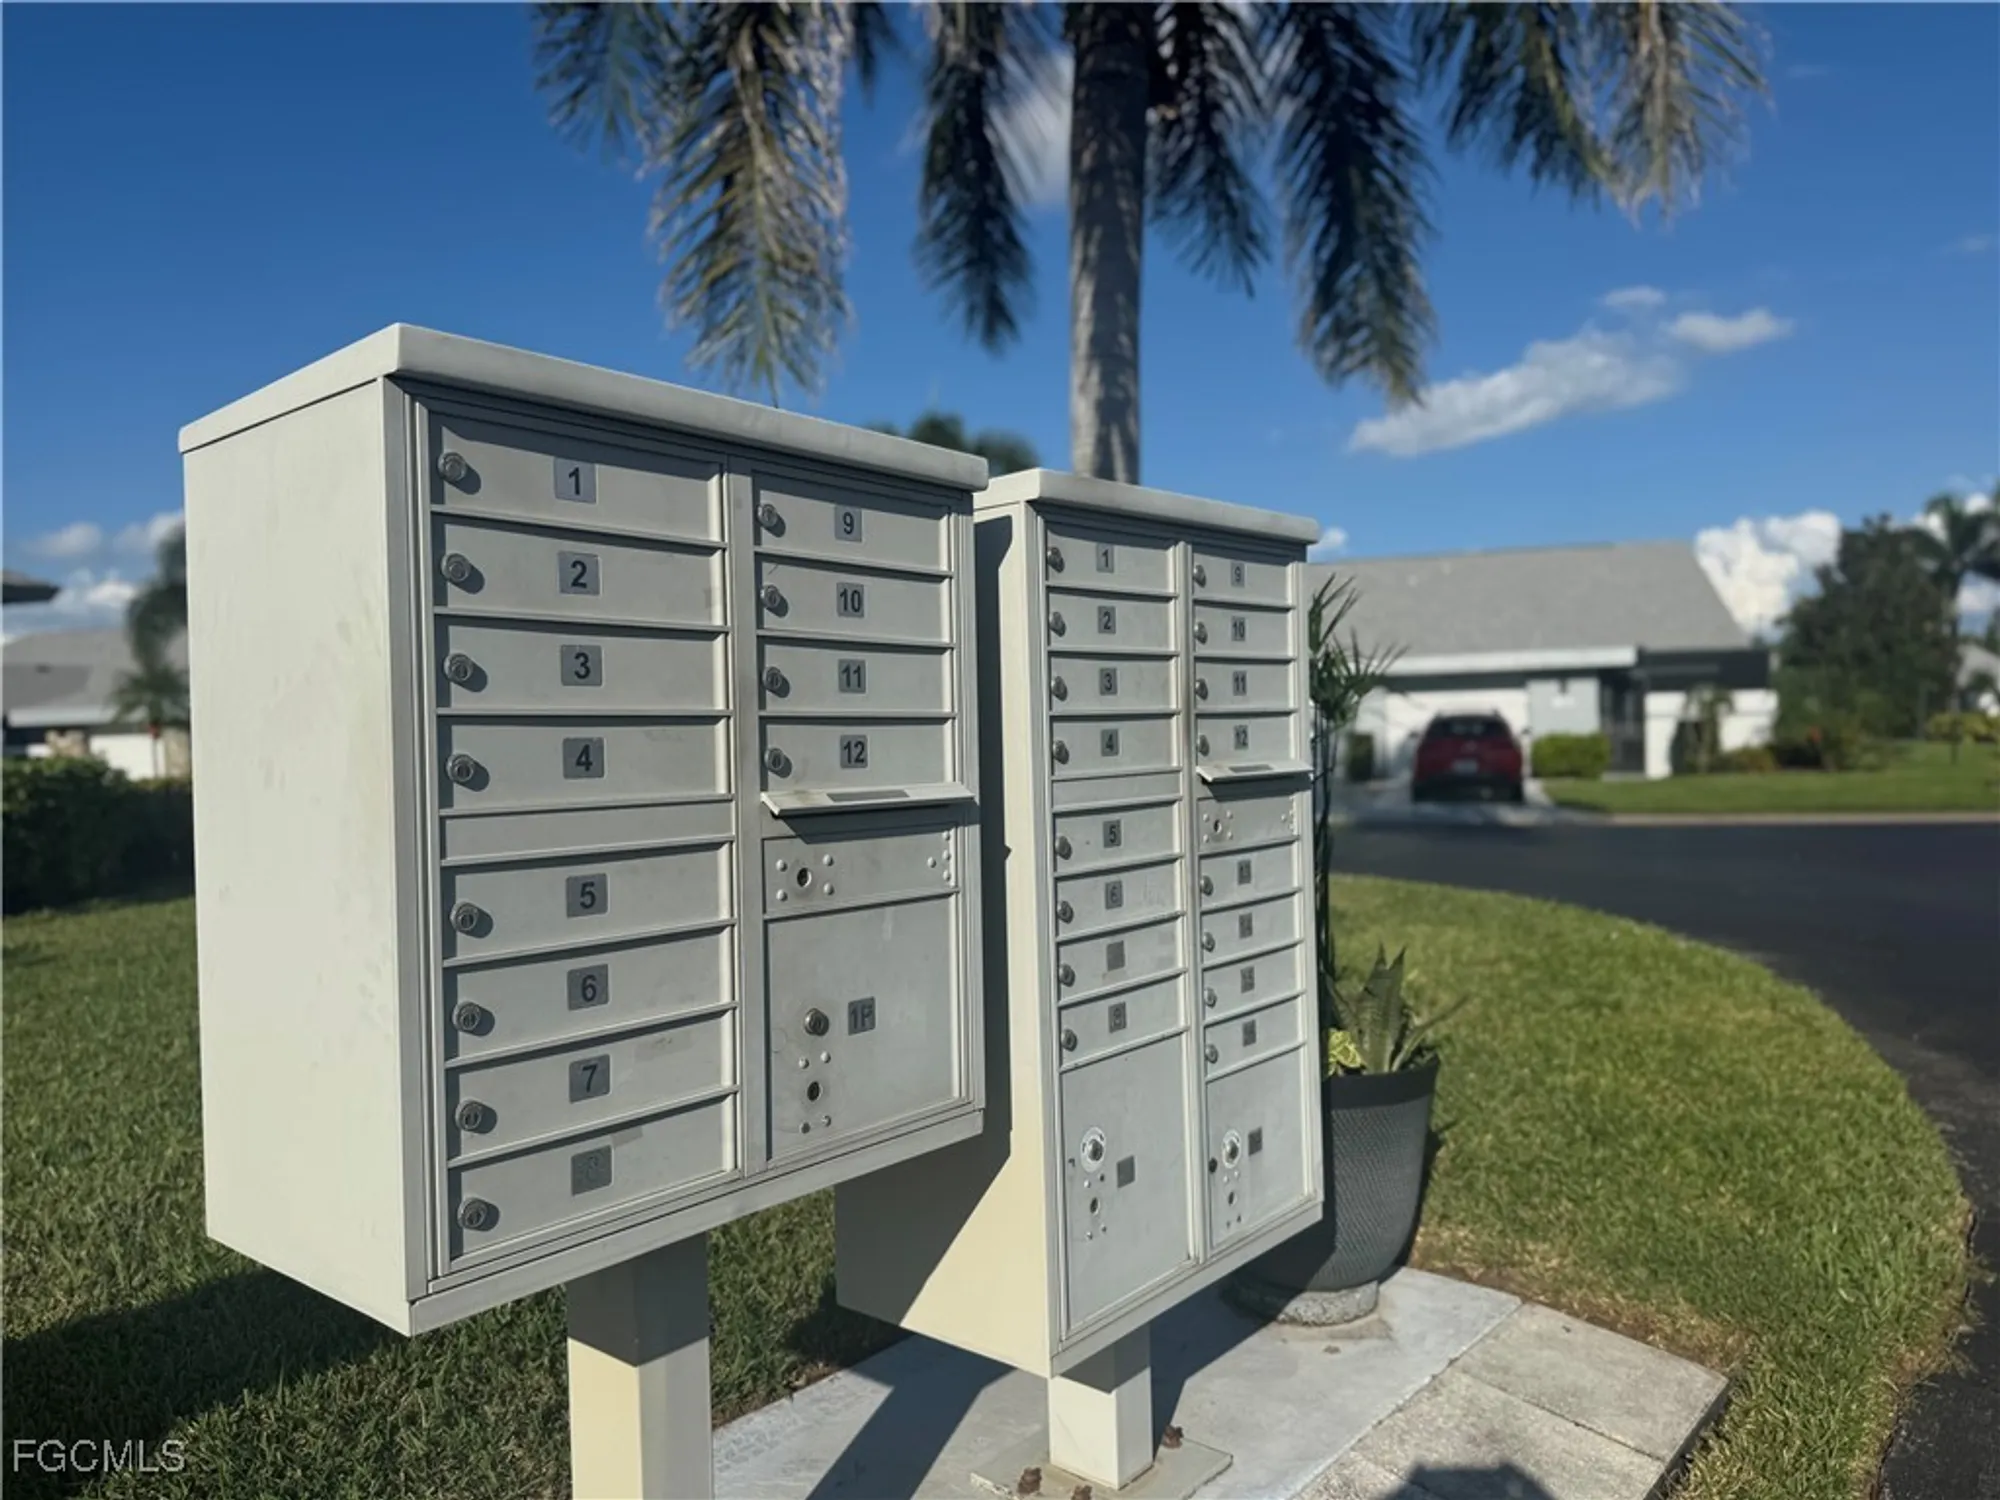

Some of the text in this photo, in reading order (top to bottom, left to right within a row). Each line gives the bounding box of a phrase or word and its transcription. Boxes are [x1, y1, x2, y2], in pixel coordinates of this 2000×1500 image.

[568, 468, 581, 496] 1
[843, 513, 855, 536] 9
[1101, 549, 1109, 568] 1
[570, 560, 588, 589] 2
[1234, 566, 1241, 582] 9
[839, 589, 862, 613] 10
[1103, 611, 1112, 630] 2
[1232, 622, 1245, 639] 10
[573, 652, 591, 681] 3
[841, 664, 863, 688] 11
[1104, 673, 1113, 692] 3
[843, 741, 865, 765] 12
[1105, 734, 1114, 752] 4
[575, 744, 593, 772] 4
[1109, 824, 1117, 843] 5
[579, 881, 596, 909] 5
[580, 974, 597, 1003] 6
[582, 1063, 598, 1092] 7
